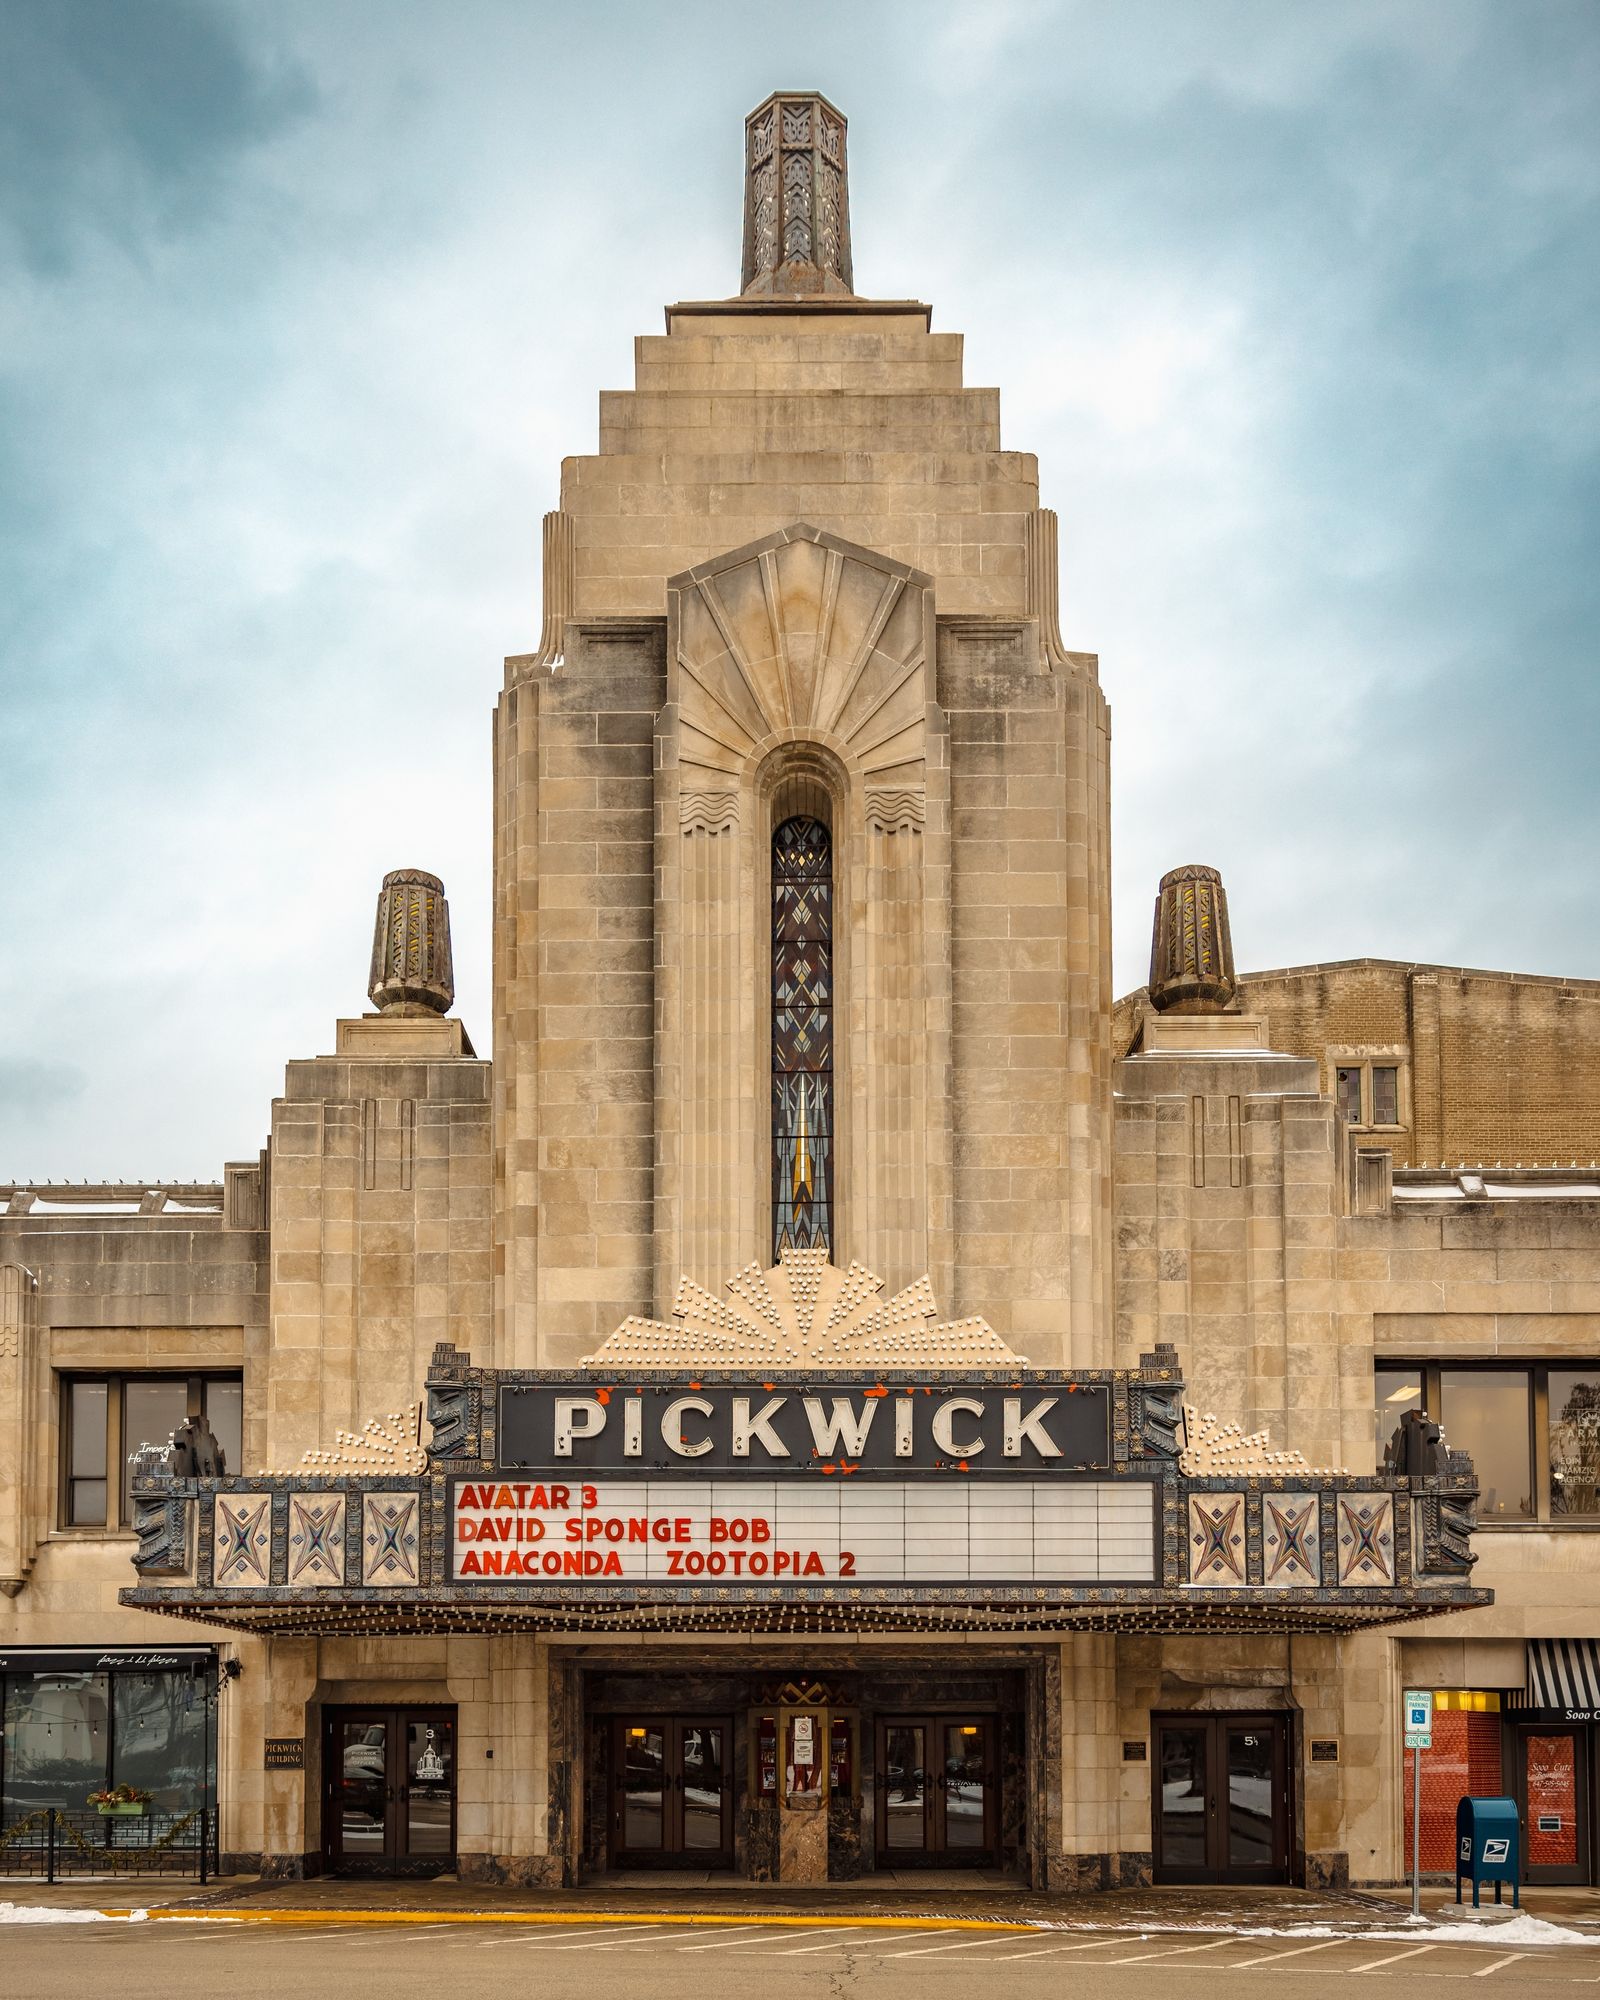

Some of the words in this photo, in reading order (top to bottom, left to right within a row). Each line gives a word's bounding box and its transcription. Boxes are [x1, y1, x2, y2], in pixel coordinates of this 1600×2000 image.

[554, 1397, 1063, 1457] PICKWICK
[1560, 1475, 1596, 1483] AGENCY
[458, 1485, 569, 1509] AVATAR
[582, 1486, 598, 1509] 3
[458, 1517, 545, 1542] DAVID
[565, 1518, 691, 1542] SPONGE
[710, 1519, 770, 1543] BOB
[460, 1551, 623, 1575] ANACONDA
[667, 1551, 825, 1576] ZOOTOPIA
[839, 1552, 856, 1576] 2
[1565, 1709, 1591, 1720] Sooo
[425, 1729, 434, 1739] 3
[265, 1744, 303, 1753] PICKWICK
[267, 1755, 301, 1763] BUILDING
[1553, 1762, 1571, 1771] Cute
